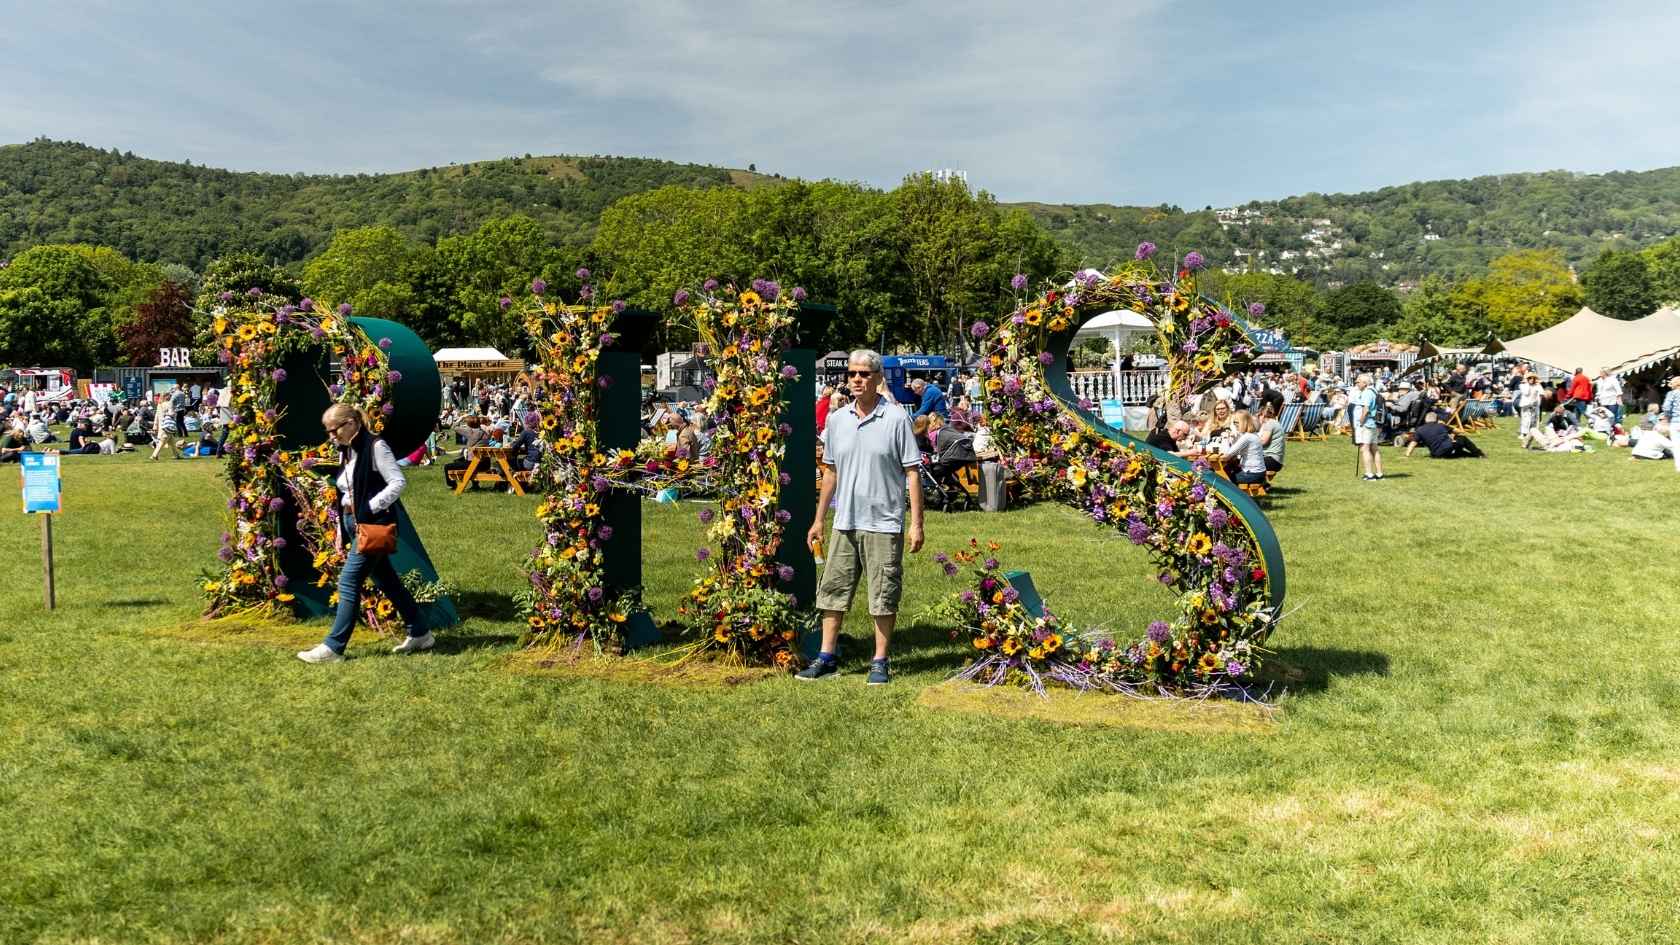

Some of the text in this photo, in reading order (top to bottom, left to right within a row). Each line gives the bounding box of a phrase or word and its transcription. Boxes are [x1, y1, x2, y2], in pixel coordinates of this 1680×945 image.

[159, 347, 192, 368] BAR
[458, 360, 482, 368] Plant
[826, 359, 843, 368] STEAK
[202, 252, 1286, 703] RHS
